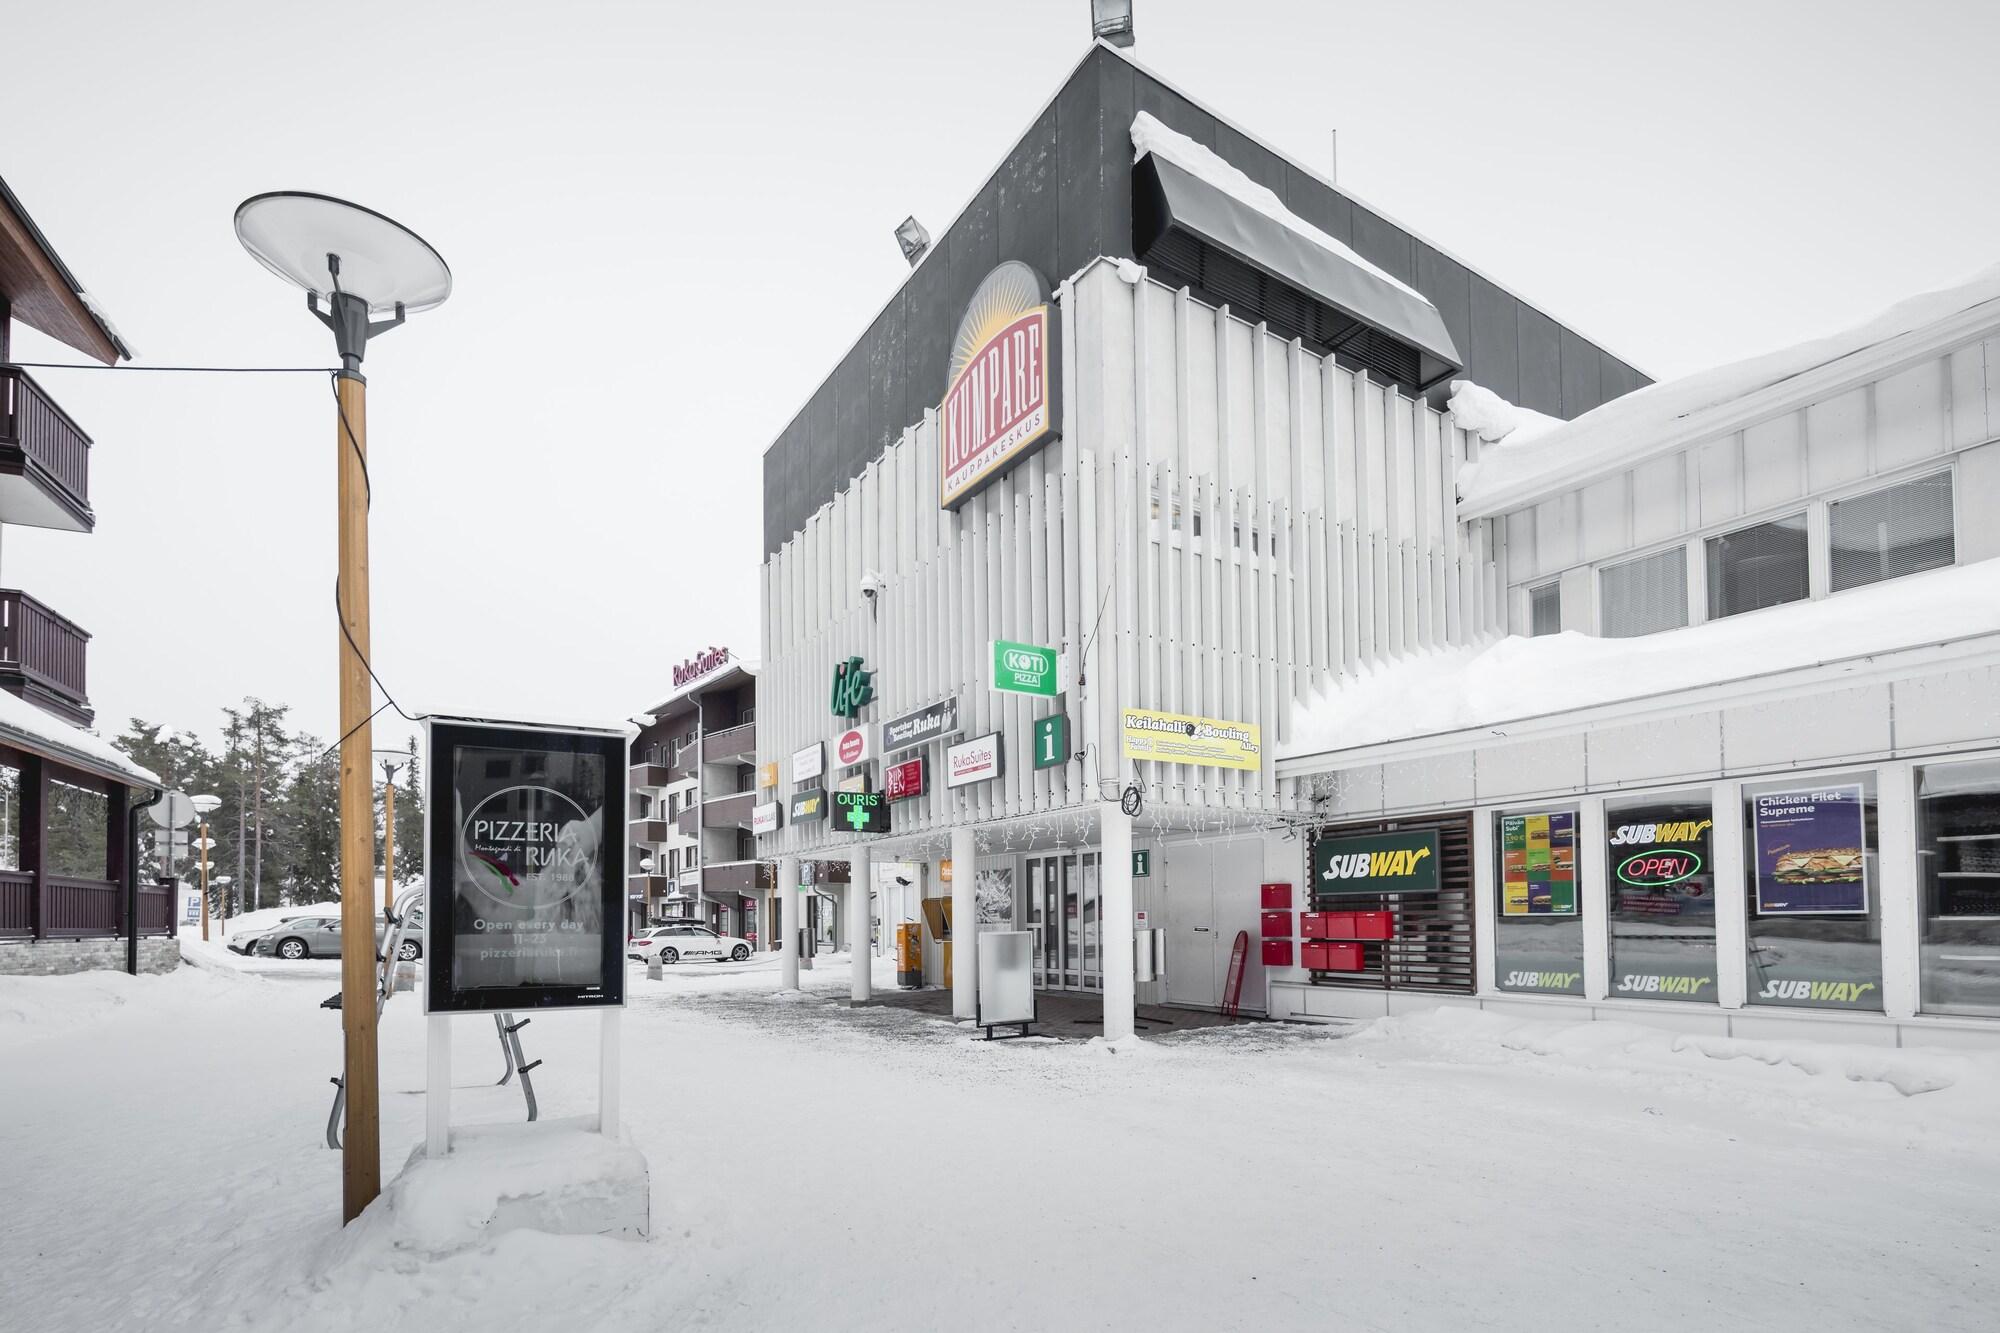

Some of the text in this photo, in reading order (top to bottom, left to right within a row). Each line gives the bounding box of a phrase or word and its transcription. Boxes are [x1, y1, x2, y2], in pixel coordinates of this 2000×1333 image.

[948, 322, 1040, 470] KUMPARE
[947, 413, 1041, 492] KAUPPAKESKUS
[1009, 652, 1043, 673] KOTI
[1014, 672, 1038, 684] PIZZA
[913, 713, 941, 735] Ruka
[1126, 714, 1186, 734] Keilahalli
[1204, 724, 1250, 741] Bowling
[953, 749, 992, 768] RukaSuites
[1759, 791, 1842, 806] Chicken Filet
[1759, 805, 1815, 817] Supreme
[474, 820, 577, 843] PIZZERIA
[1610, 819, 1712, 845] SUBWAY
[526, 846, 589, 868] RUKA
[1322, 846, 1431, 880] SUBWAY
[1628, 858, 1688, 876] OPEN
[474, 919, 513, 933] Open
[560, 919, 584, 932] day
[1504, 971, 1580, 989] SUBWAY
[1617, 974, 1711, 994] SUBWAY
[1758, 980, 1875, 1002] SUBWAY
